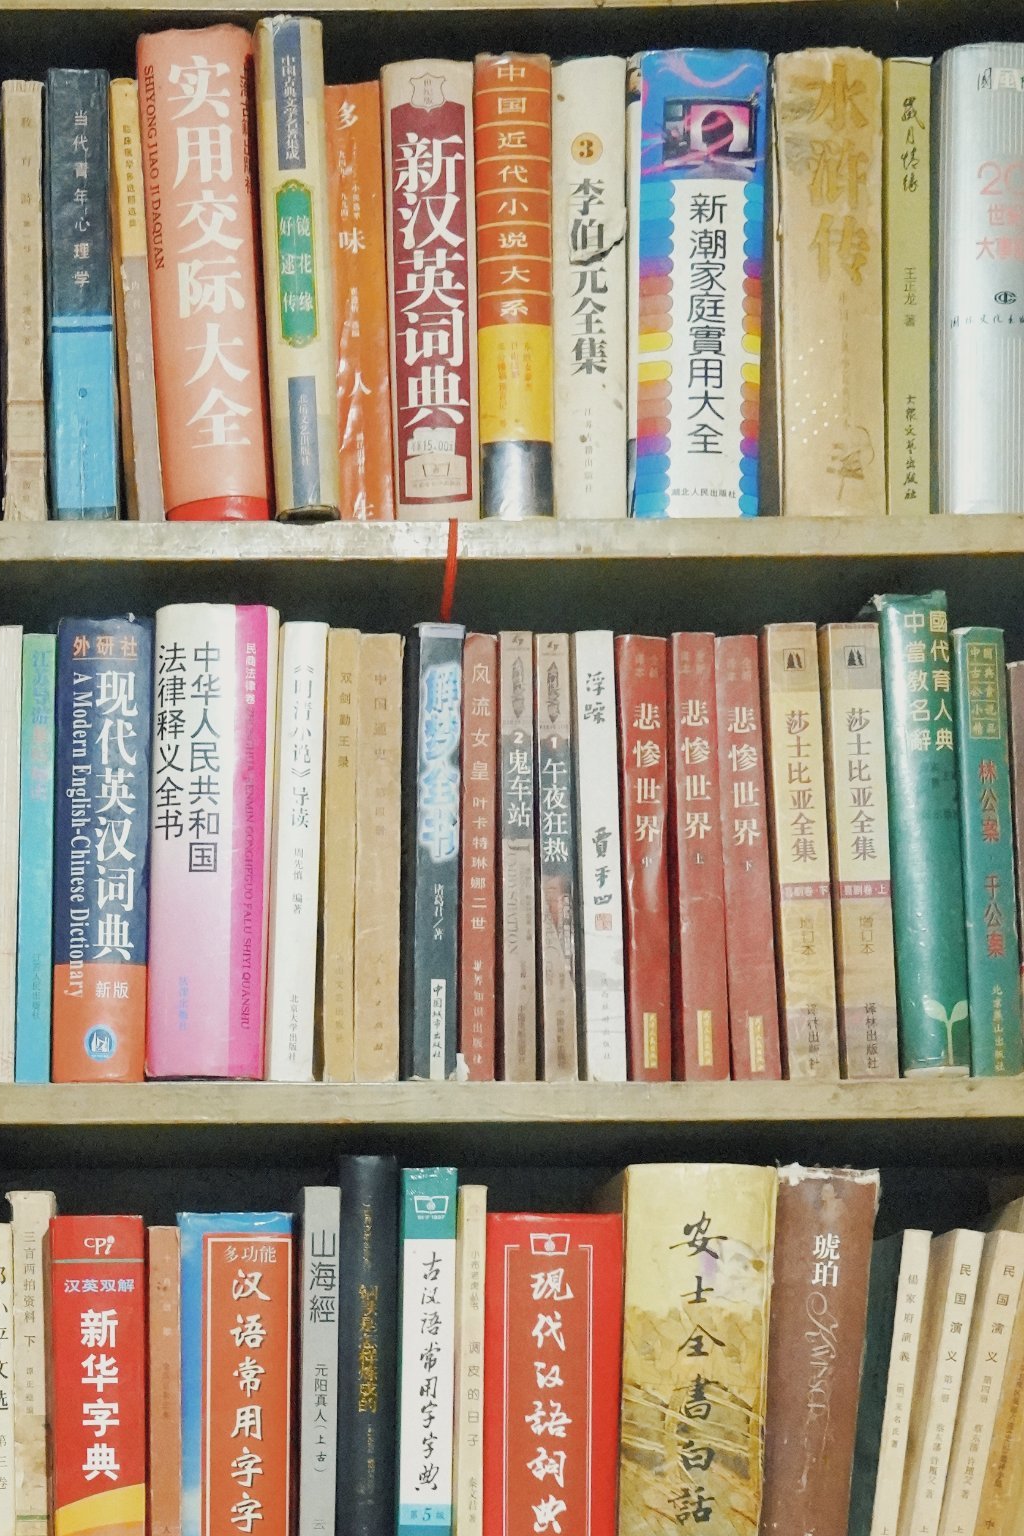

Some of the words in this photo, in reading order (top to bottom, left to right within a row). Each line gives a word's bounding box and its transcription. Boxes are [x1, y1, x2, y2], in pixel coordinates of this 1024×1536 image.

[144, 65, 158, 139] SHIYONG
[151, 201, 165, 270] DAQUAN
[497, 62, 530, 316] 中国近代小说大系
[578, 139, 594, 157] 3
[167, 55, 254, 449] 实用交际大全
[296, 215, 313, 312] 镜花缘
[393, 132, 469, 429] 新汉英词典
[568, 178, 609, 376] 李伯元全集
[687, 192, 728, 455] 新潮家庭實用大全
[73, 636, 137, 657] 外研社
[903, 610, 948, 634] 中國
[905, 639, 950, 663] 當代
[72, 671, 93, 685] A
[244, 641, 257, 705] 民商法律卷
[910, 698, 953, 722] 名人
[72, 690, 93, 759] Modern
[155, 643, 187, 841] 法律释义全书
[188, 641, 221, 874] 中华人民共和国
[421, 663, 460, 861] 解梦全书
[513, 731, 524, 744] 2
[551, 738, 557, 749] 1
[680, 699, 712, 840] 悲惨世界
[92, 670, 137, 961] 现代英汉词典
[506, 748, 532, 829] 鬼车站
[542, 758, 570, 863] 午夜狂热
[632, 703, 662, 843] 悲惨世界
[727, 706, 761, 847] 悲惨世界
[785, 709, 818, 862] 莎士比亚全集
[846, 708, 877, 861] 莎士比亚全集
[66, 762, 93, 902] English-Chinese
[470, 797, 487, 931] 叶卡特琳娜二世
[641, 856, 653, 868] 中
[695, 853, 705, 865] 上
[743, 862, 753, 873] 下
[63, 907, 90, 999] Dictionary
[858, 915, 876, 955] 增订本
[95, 980, 129, 1000] 新版
[288, 993, 299, 1061] 北京大学出版社
[864, 1002, 879, 1069] 译林出版社
[23, 1230, 36, 1324] 三言两拍资料
[63, 1279, 135, 1294] 汉英双解
[224, 1245, 277, 1263] 多功能
[309, 1230, 337, 1324] 山海經
[811, 1233, 839, 1287] 琥珀
[24, 1334, 36, 1348] 下
[944, 1263, 972, 1363] 民国演义
[984, 1264, 1016, 1364] 民国演义
[80, 1308, 121, 1482] 新华字典
[415, 1253, 443, 1492] 古汉语常用字字典
